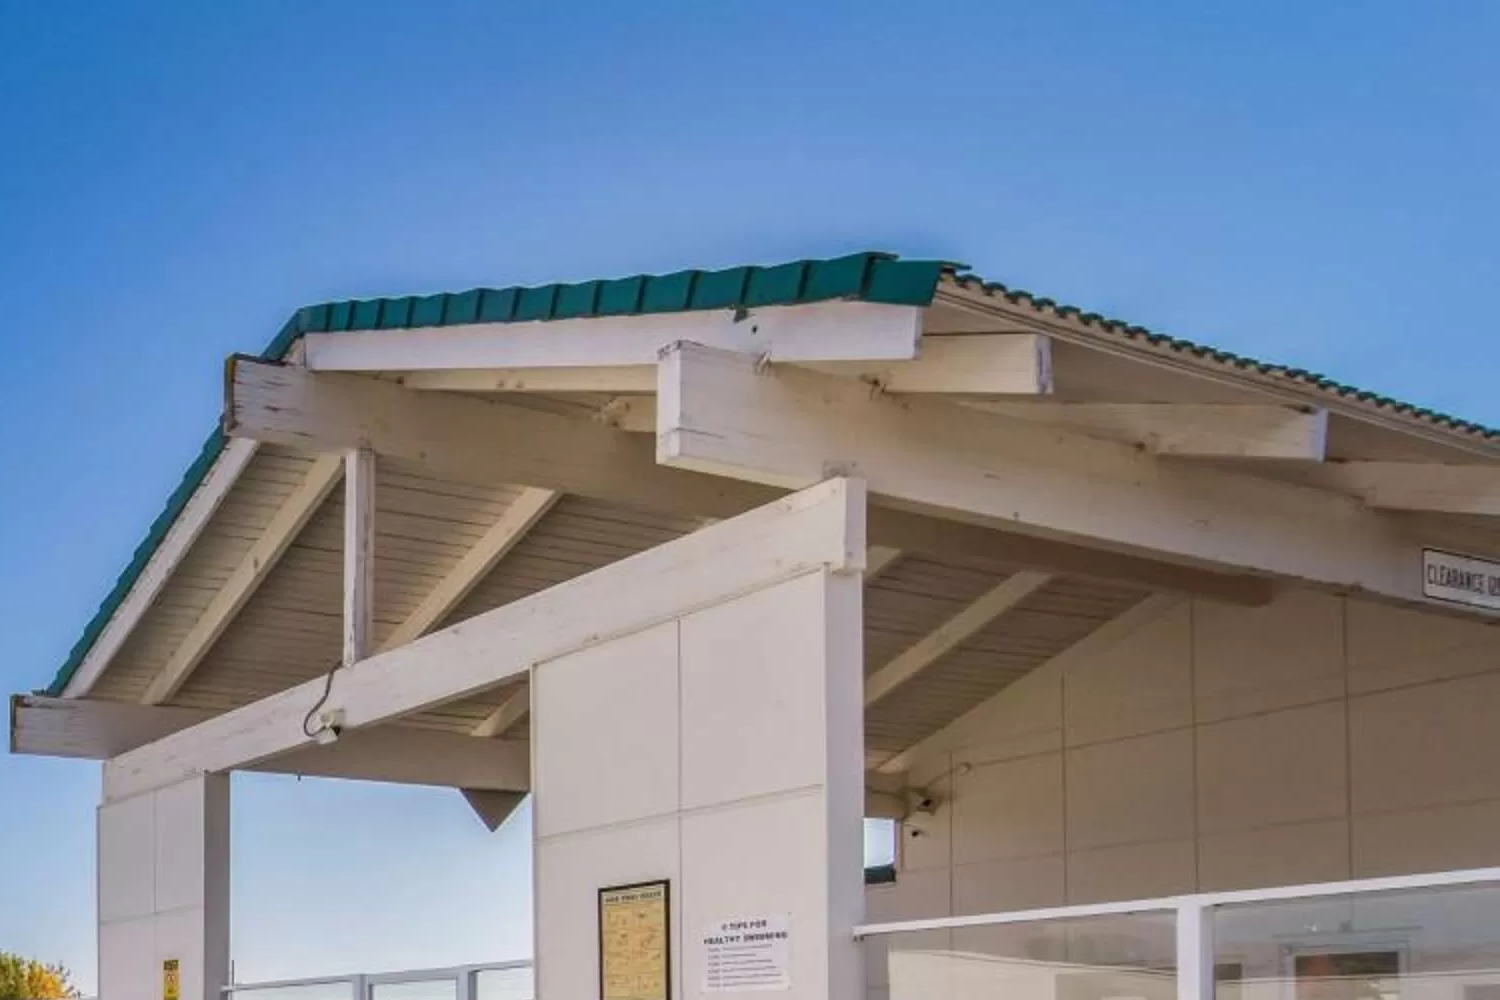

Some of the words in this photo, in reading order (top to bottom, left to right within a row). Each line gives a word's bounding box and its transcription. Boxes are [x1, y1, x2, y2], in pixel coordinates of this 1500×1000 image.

[1427, 563, 1486, 595] CLEARANCE
[749, 919, 767, 929] FOR
[703, 934, 741, 945] HEALTHY
